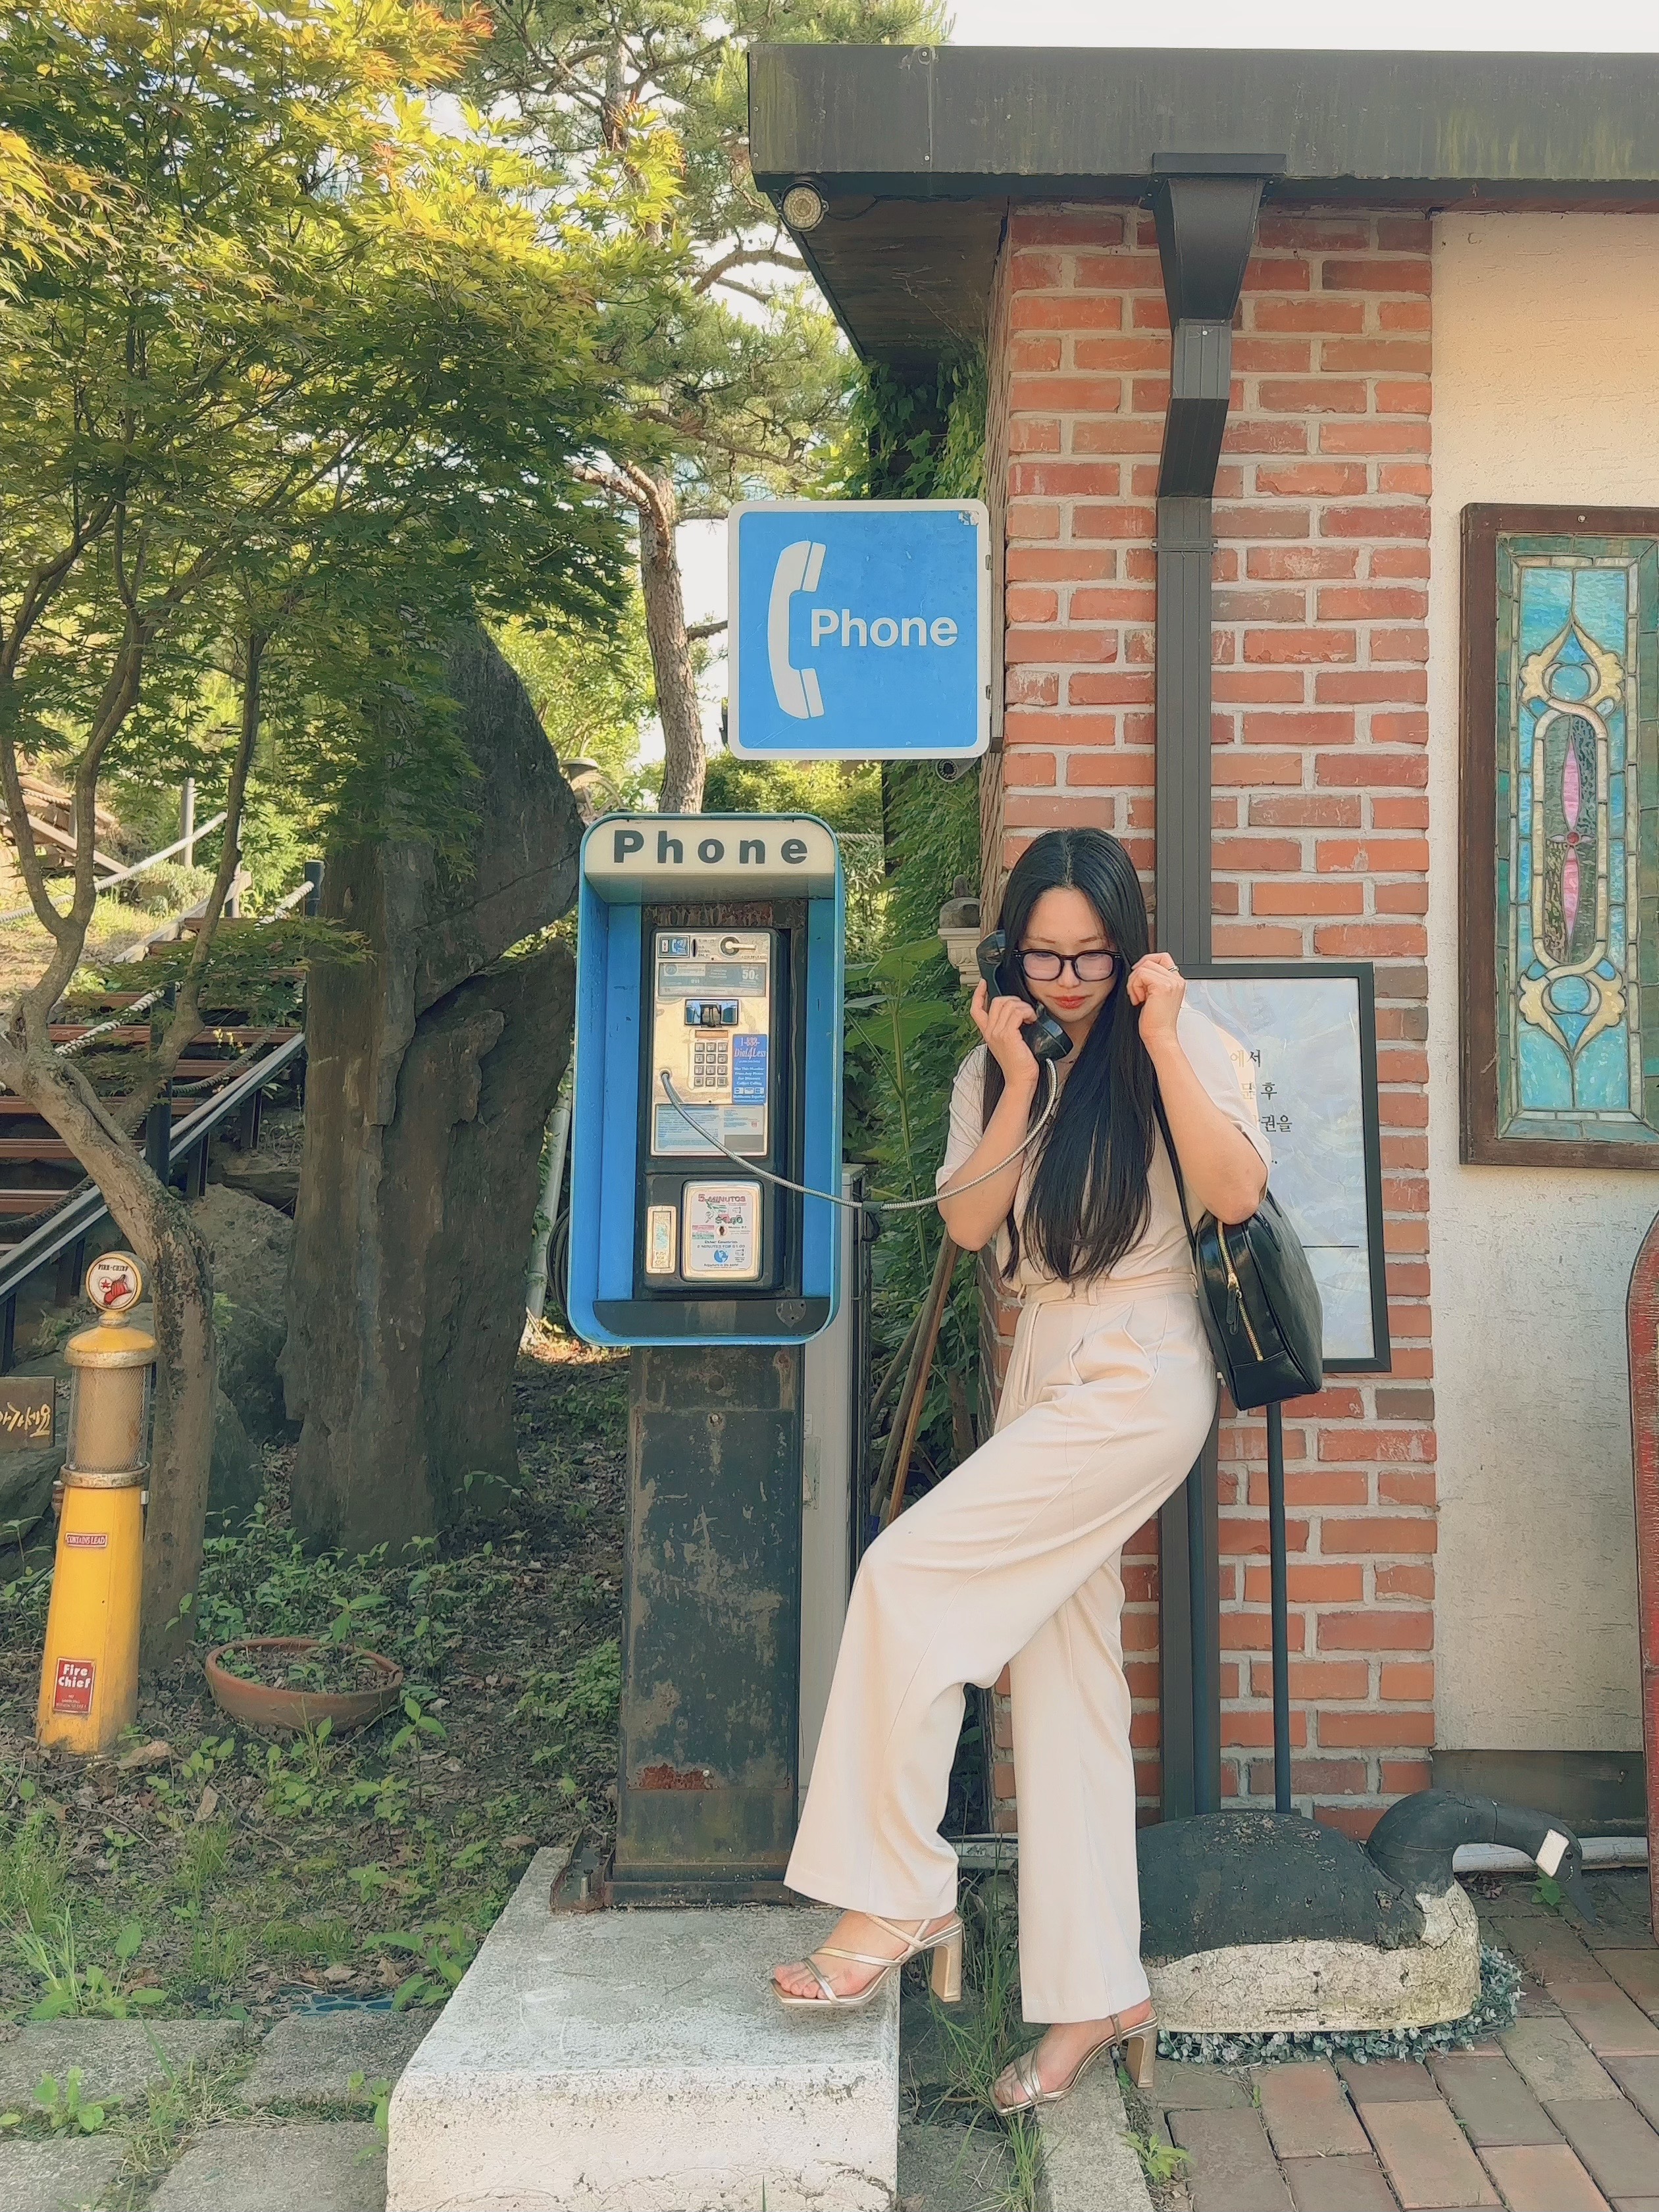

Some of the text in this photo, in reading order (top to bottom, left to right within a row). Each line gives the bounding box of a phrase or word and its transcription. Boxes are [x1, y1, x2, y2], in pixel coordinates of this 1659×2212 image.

[811, 608, 958, 648] Phone
[613, 830, 808, 865] Phone
[1260, 1082, 1277, 1100] 후
[90, 1536, 105, 1545] LEAD
[63, 1663, 88, 1677] Fire
[58, 1676, 91, 1689] Chief
